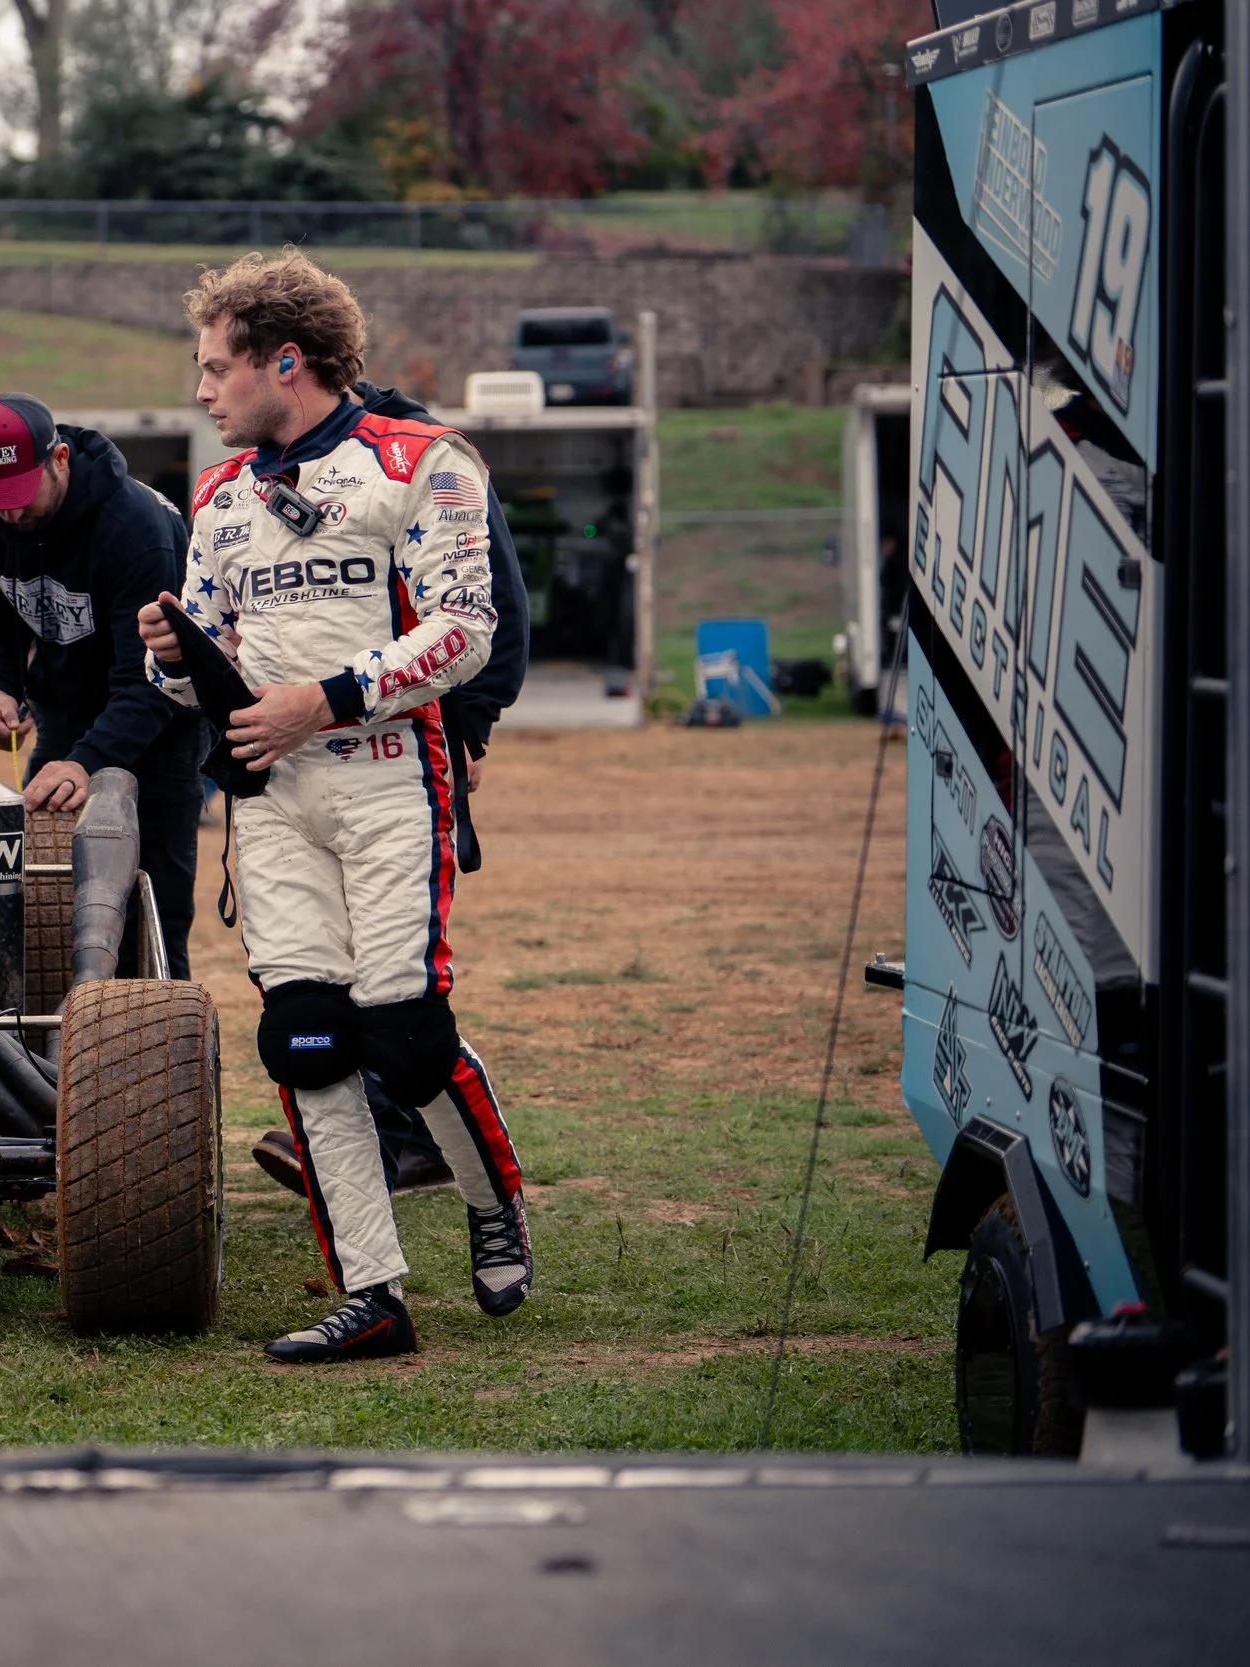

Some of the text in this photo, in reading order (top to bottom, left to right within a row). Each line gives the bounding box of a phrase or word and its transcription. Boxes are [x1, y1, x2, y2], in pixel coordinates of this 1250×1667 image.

[1067, 135, 1152, 415] 19
[261, 588, 350, 607] FINISHLINE
[378, 627, 468, 700] CALICO
[913, 502, 1113, 891] ELECTRICAL
[366, 732, 404, 761] 16
[291, 1035, 331, 1047] sparco
